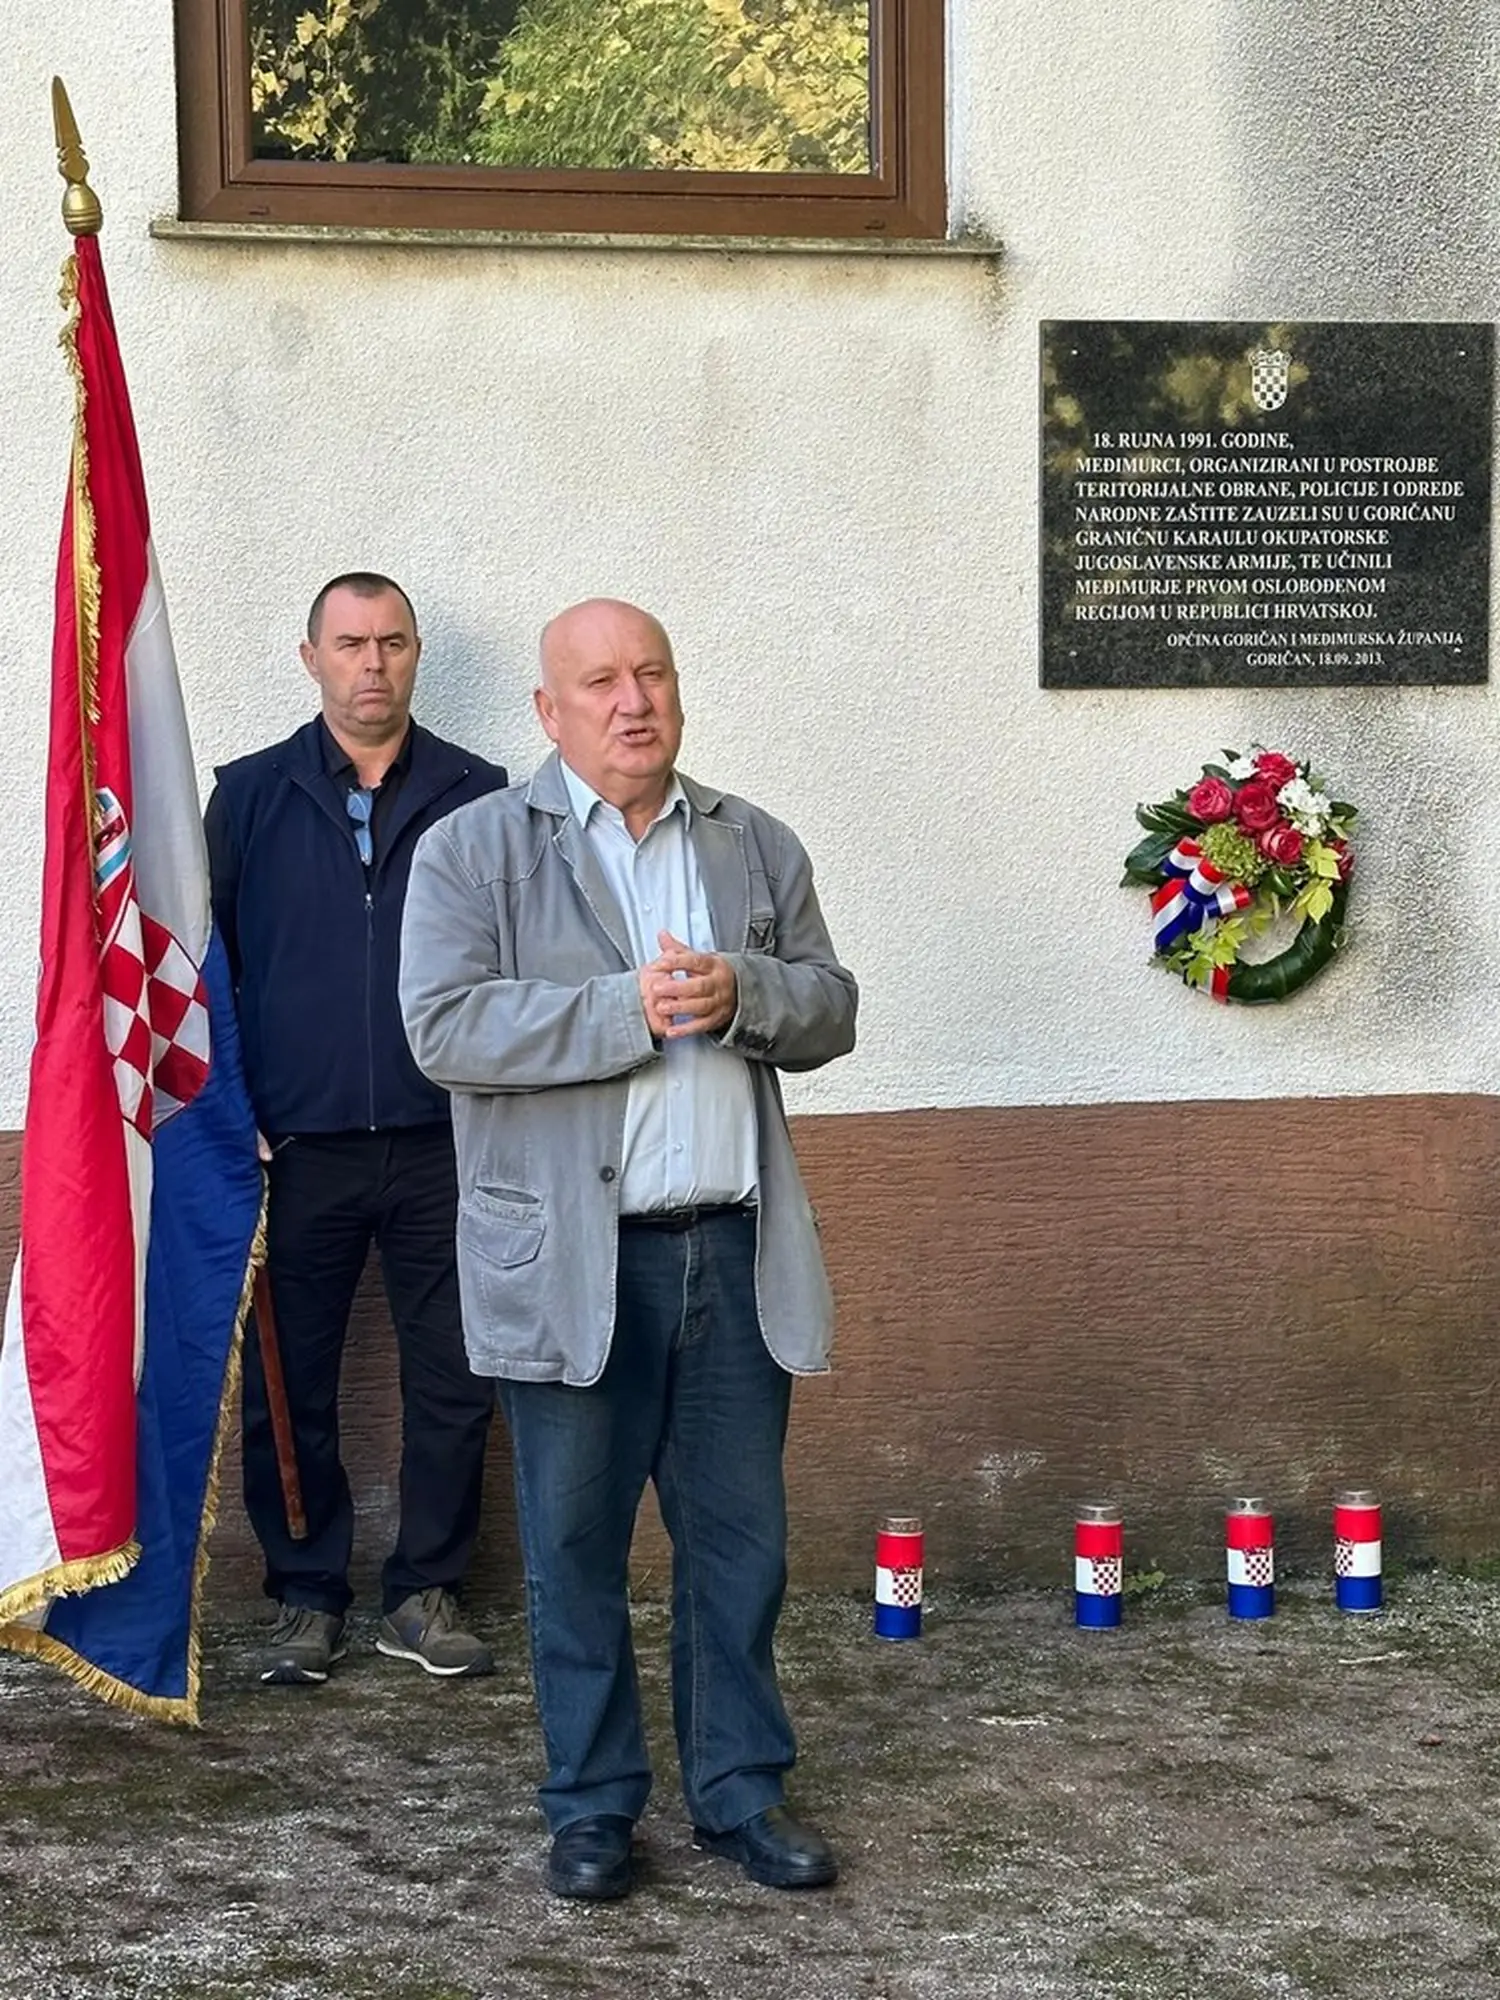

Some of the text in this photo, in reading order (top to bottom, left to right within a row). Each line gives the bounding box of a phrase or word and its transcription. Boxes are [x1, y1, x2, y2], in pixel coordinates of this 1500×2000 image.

[1094, 433, 1294, 451] 18. RUJNA 1991. GODINE,
[1189, 458, 1319, 473] ORGANIZIRANI
[1324, 458, 1336, 473] U
[1340, 457, 1439, 473] POSTROJBE
[1075, 482, 1465, 499] TERITORIJALNE OBRANE, POLICIJE I ODREDE
[1075, 502, 1456, 521] NARODNE ZAŠTITE ZAUZELI SU U GORIČANU
[1075, 527, 1389, 546] GRANIČNU KARAULU OKUPATORSKE
[1075, 551, 1393, 572] JUGOSLAVENSKE ARMIJE, TE UČINILI
[1186, 579, 1248, 594] PRVOM
[1075, 603, 1378, 620] REGIJOM U REPUBLICI HRVATSKOJ.
[1167, 631, 1220, 646] OPĆINA
[1223, 630, 1288, 646] GORIČAN
[1291, 633, 1298, 645] I
[1397, 629, 1463, 645] ŽUPANIJA
[1246, 650, 1385, 667] GORIČAN, 18.09. 2013.
